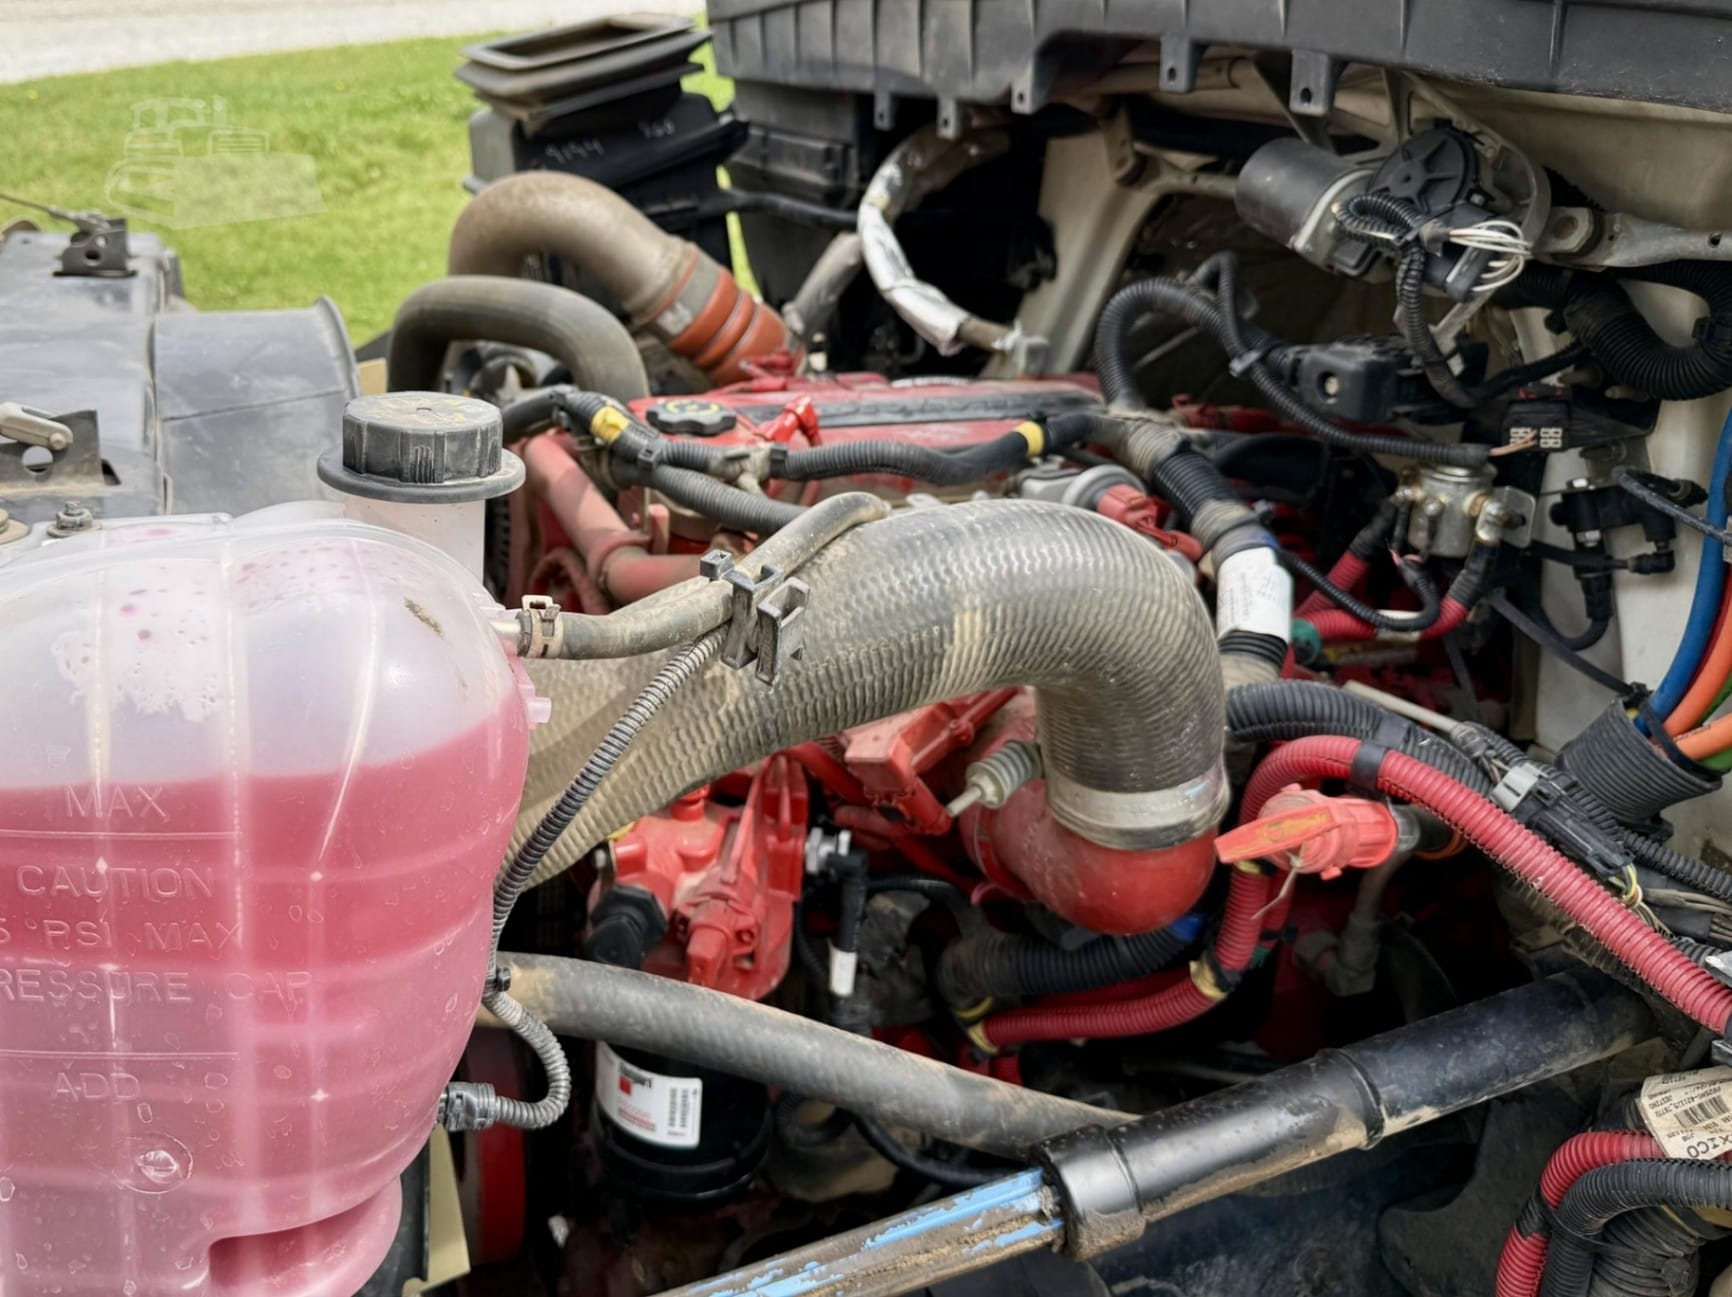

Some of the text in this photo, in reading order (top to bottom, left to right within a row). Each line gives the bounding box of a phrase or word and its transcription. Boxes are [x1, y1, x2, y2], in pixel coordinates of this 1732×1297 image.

[65, 785, 169, 819] MAX
[16, 865, 214, 898] CAUTION
[43, 919, 112, 949] PSI
[144, 922, 243, 951] MAX
[225, 971, 313, 1002] CAP
[51, 1072, 141, 1101] ADD
